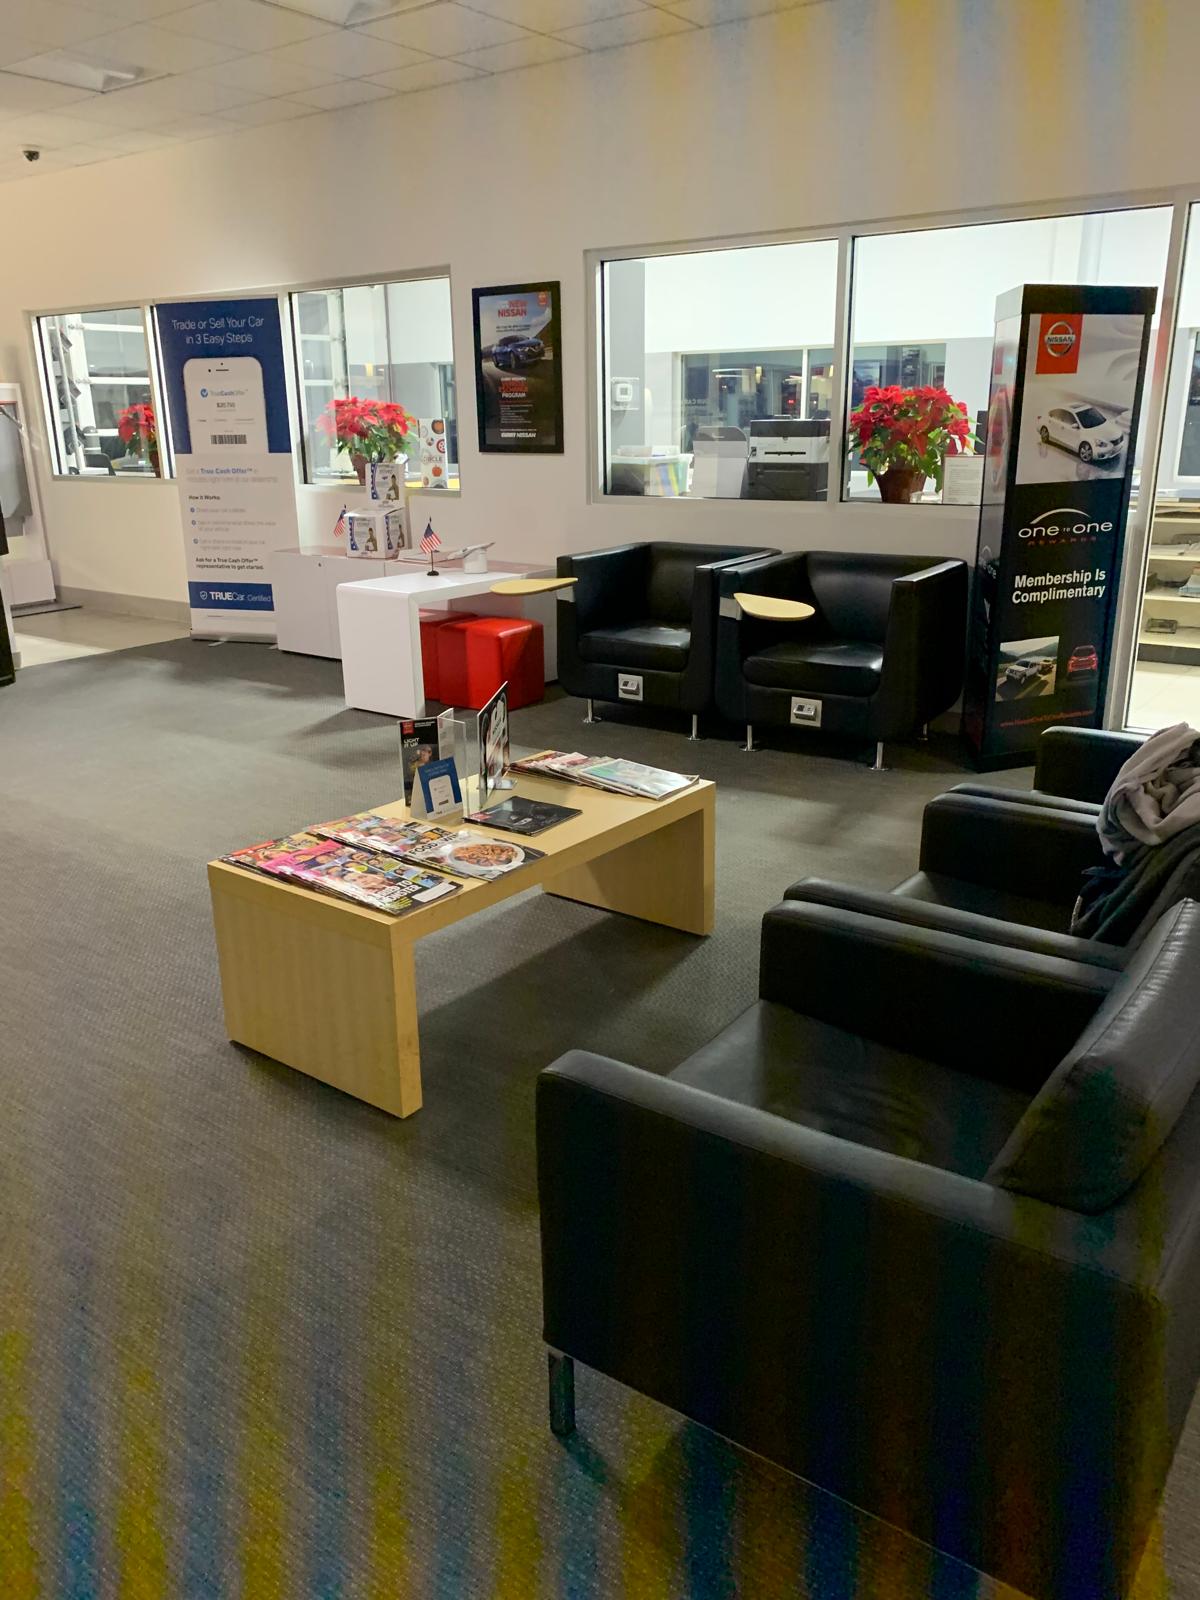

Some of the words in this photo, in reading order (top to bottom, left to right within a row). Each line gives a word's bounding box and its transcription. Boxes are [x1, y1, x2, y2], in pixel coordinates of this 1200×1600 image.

[498, 308, 527, 318] NISSAN
[171, 318, 196, 330] Trade
[197, 320, 207, 330] or
[208, 317, 225, 329] Sell
[225, 317, 247, 328] Your
[248, 315, 265, 328] Car
[185, 335, 194, 344] in
[195, 333, 202, 345] 3
[203, 333, 225, 346] Easy
[225, 332, 253, 344] Steps
[1047, 335, 1074, 344] NISSAN
[1018, 525, 1060, 538] one
[1072, 521, 1113, 534] one
[1014, 569, 1092, 589] Membership
[1094, 568, 1106, 581] Is
[246, 594, 272, 602] Certified
[1011, 585, 1106, 604] Complimentary
